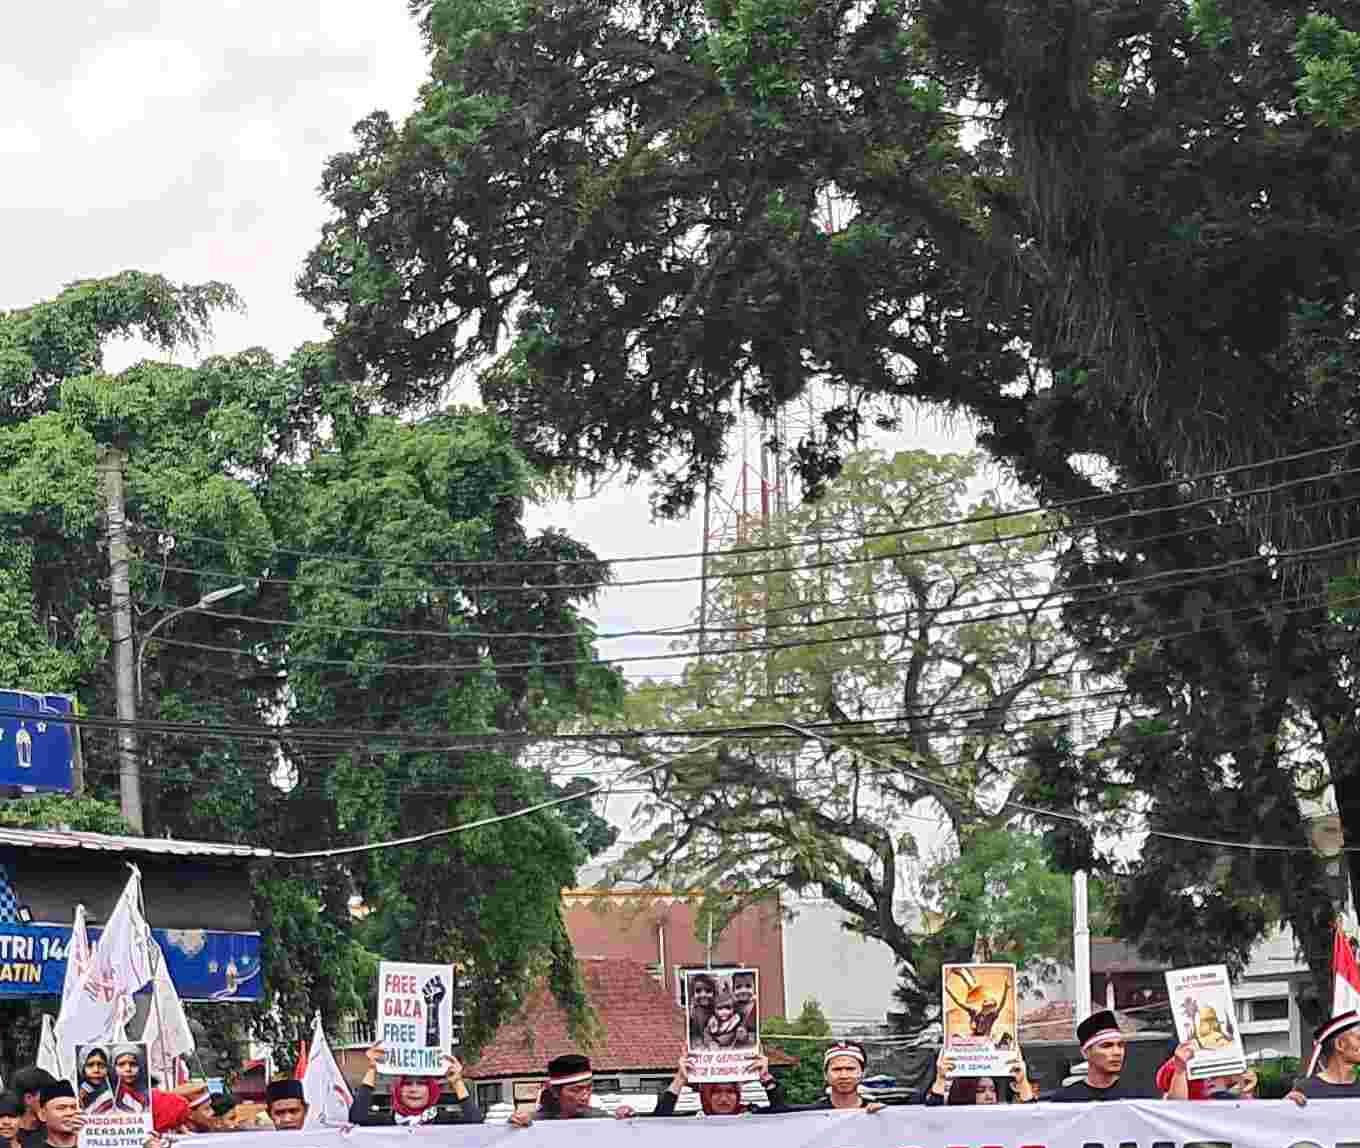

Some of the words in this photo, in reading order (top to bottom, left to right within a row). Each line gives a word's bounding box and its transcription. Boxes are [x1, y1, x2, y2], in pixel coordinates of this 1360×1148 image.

[385, 974, 416, 993] FREE
[384, 998, 422, 1018] GAZA
[384, 1023, 416, 1042] FREE
[384, 1048, 442, 1068] PALESTINE
